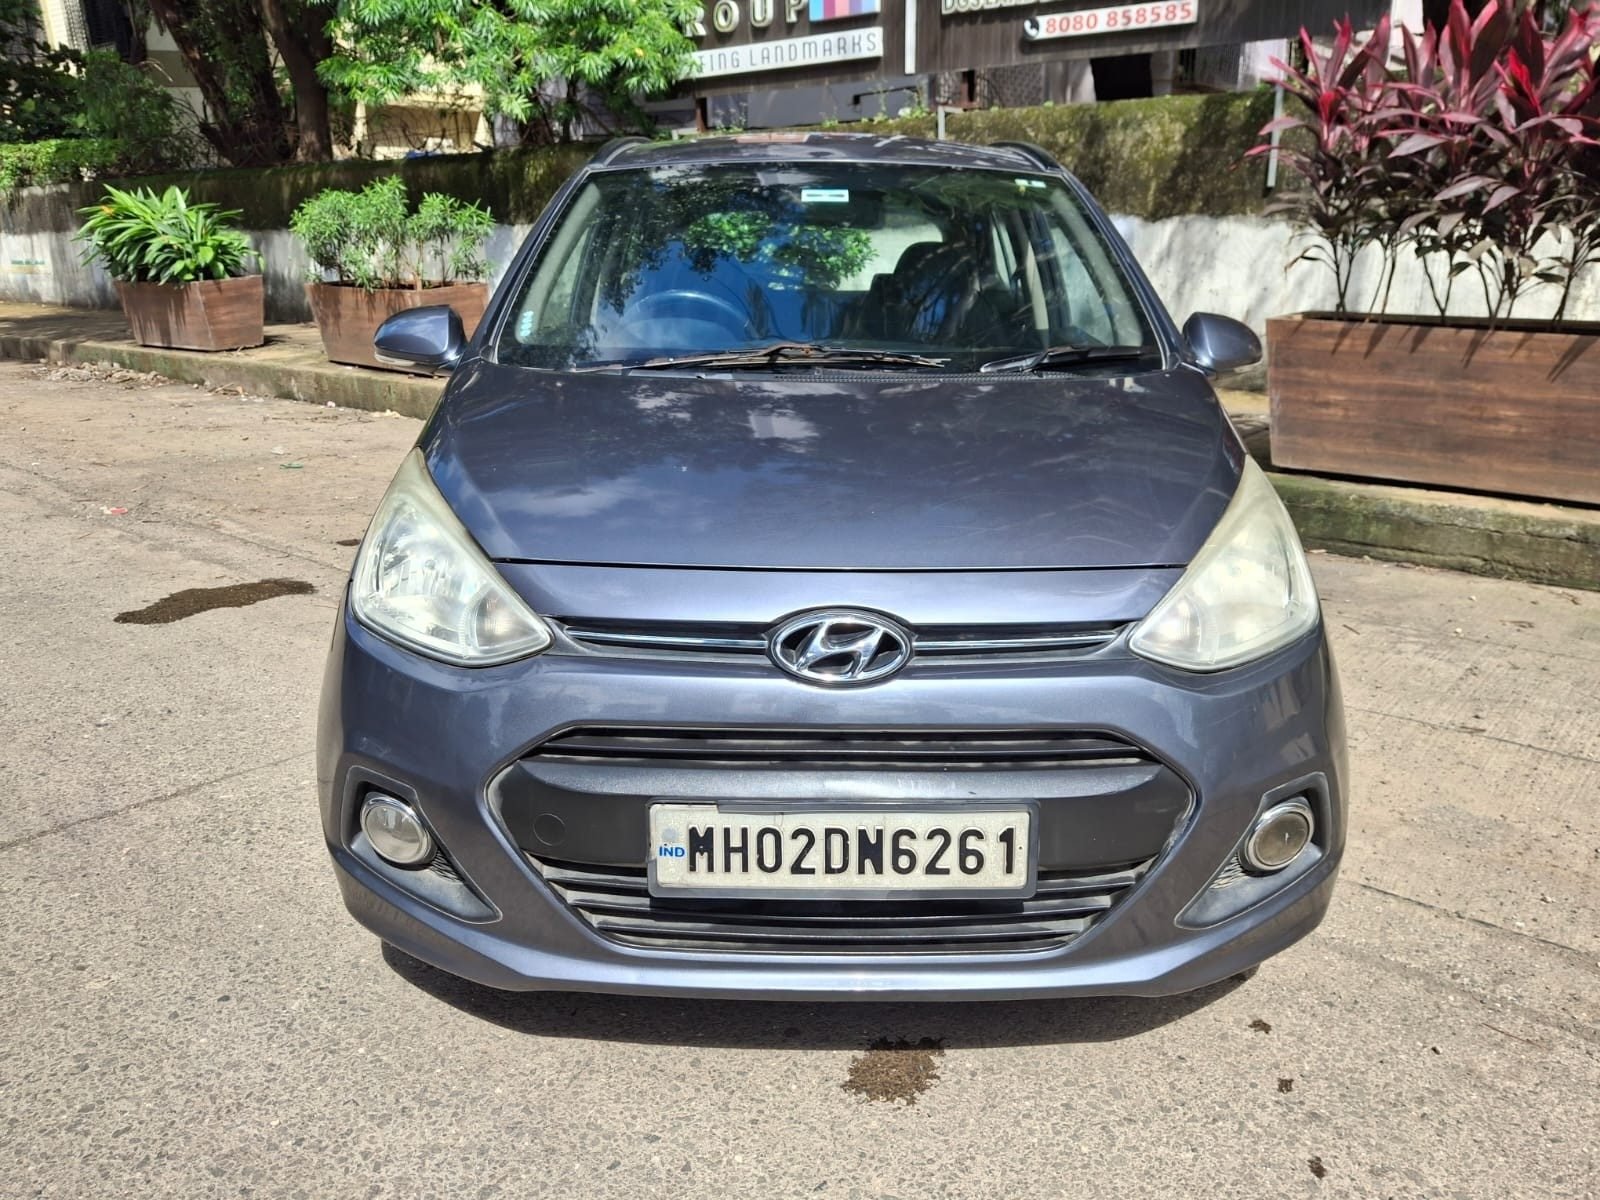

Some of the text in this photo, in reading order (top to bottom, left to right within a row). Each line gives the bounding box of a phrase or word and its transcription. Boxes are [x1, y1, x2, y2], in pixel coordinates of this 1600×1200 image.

[1046, 2, 1192, 34] 8080 858585
[750, 32, 876, 66] LANDMARKS
[659, 845, 685, 857] IND
[688, 826, 1014, 875] MH02DN6261
